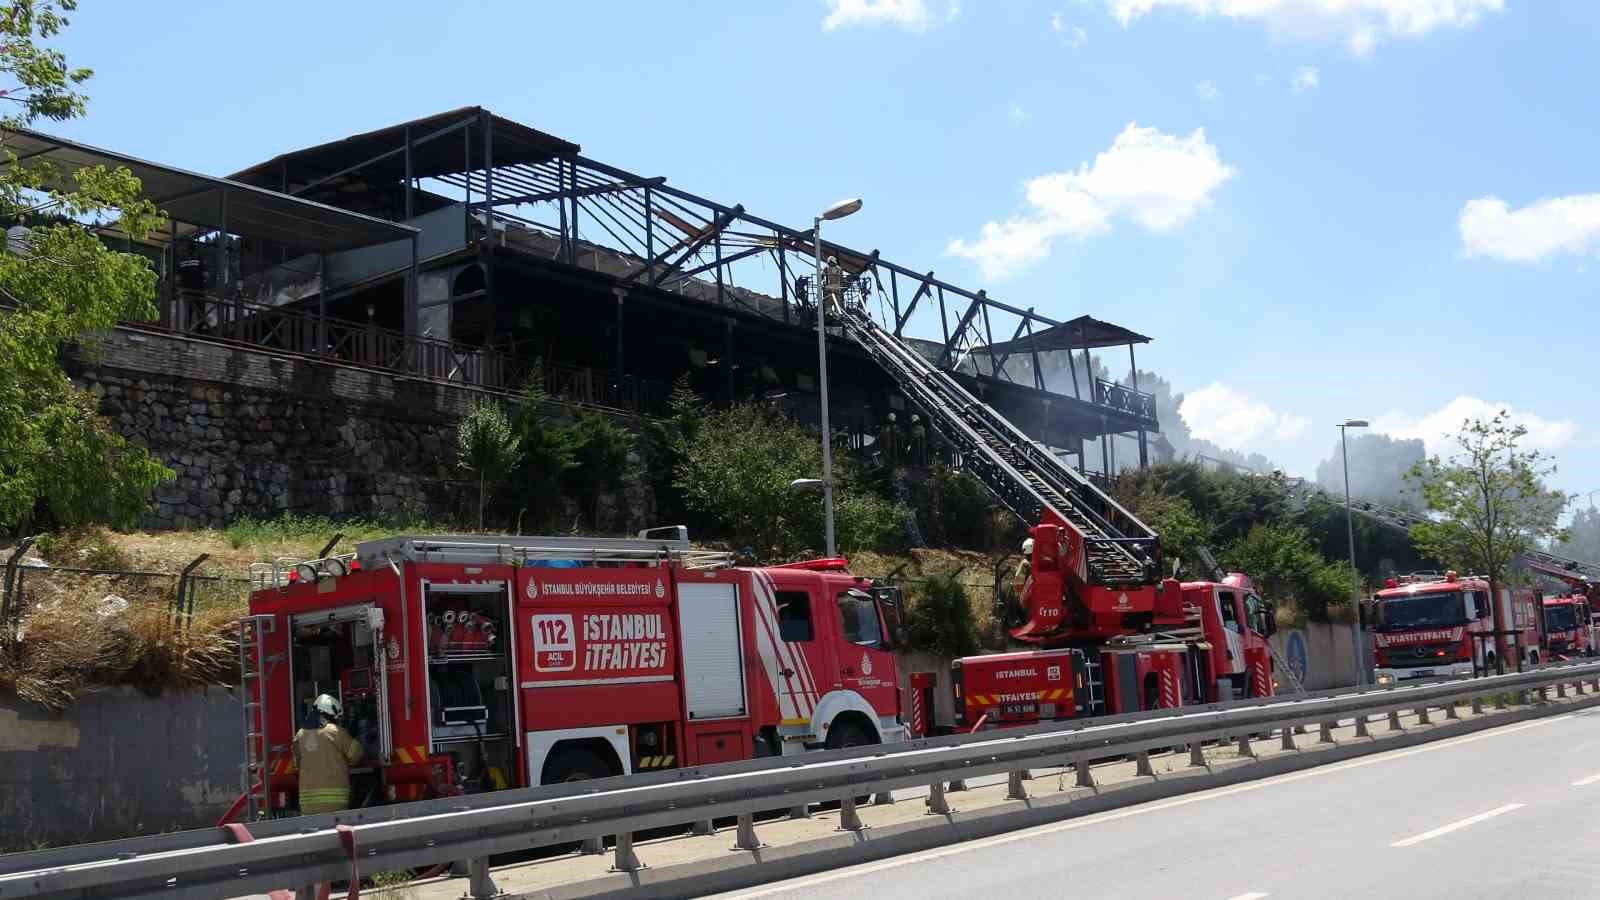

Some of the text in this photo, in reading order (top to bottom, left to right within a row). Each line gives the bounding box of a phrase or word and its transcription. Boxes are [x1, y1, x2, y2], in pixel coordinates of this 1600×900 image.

[538, 619, 569, 645] 112
[583, 614, 666, 641] İSTANBUL
[584, 642, 667, 671] İTFAİYESİ
